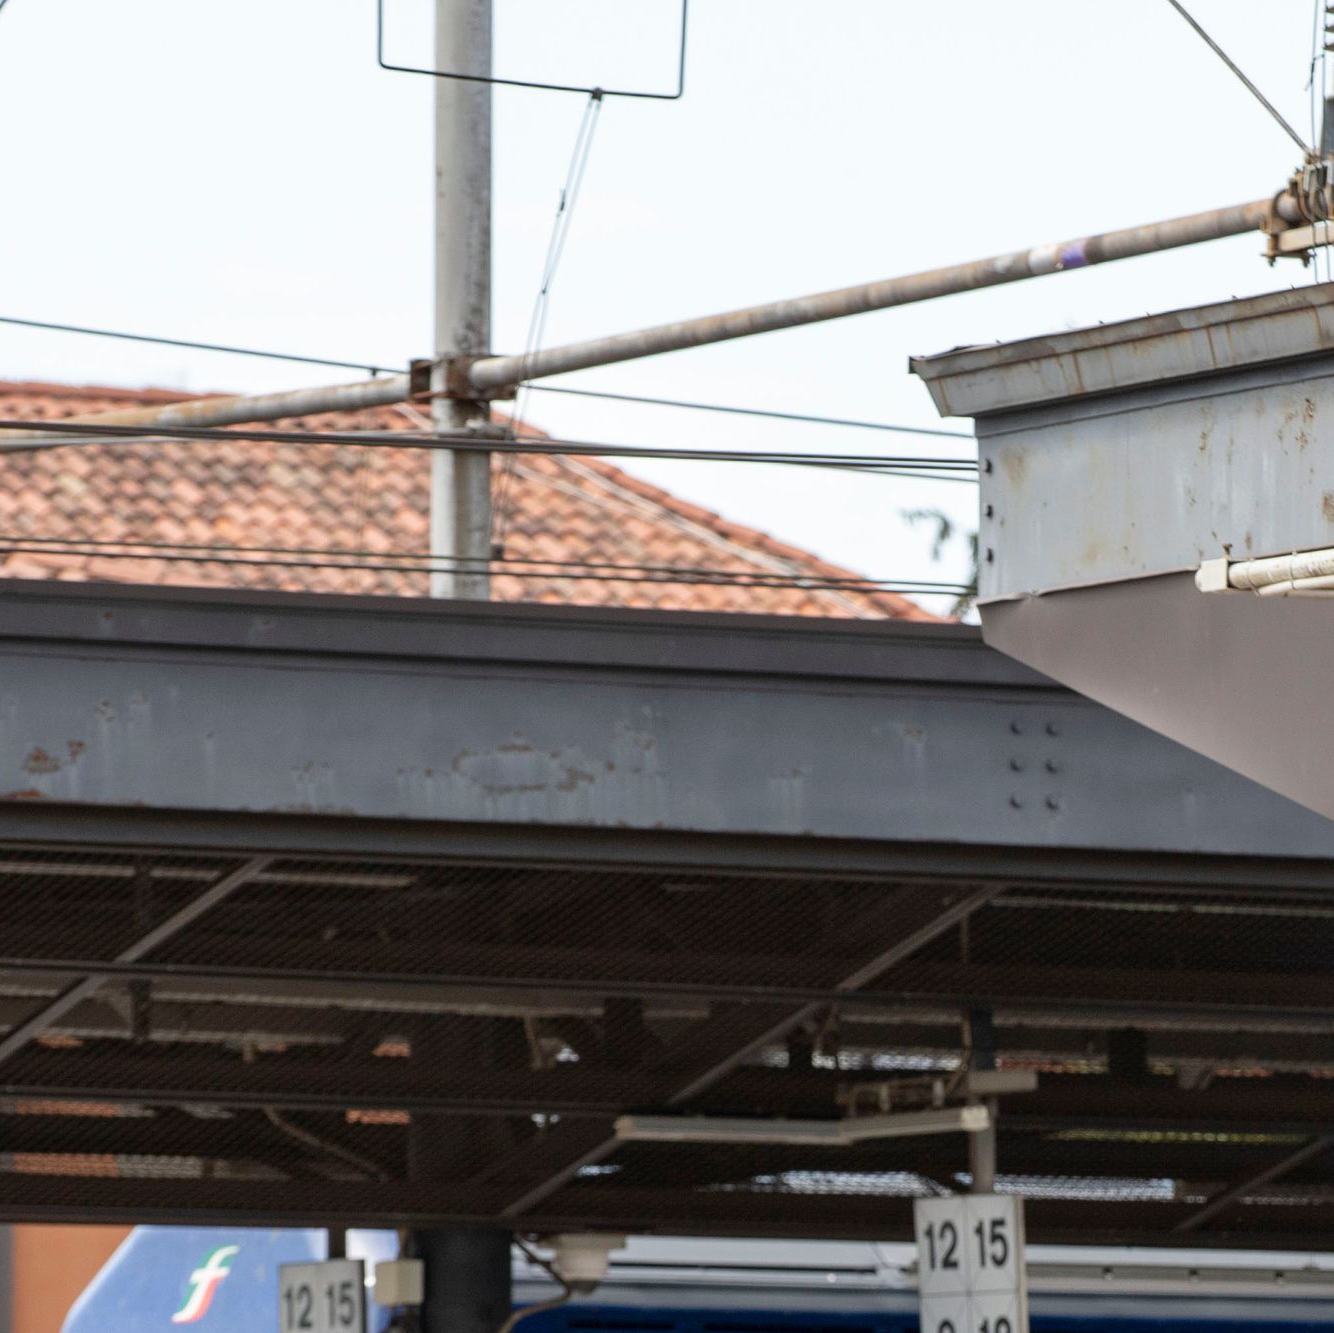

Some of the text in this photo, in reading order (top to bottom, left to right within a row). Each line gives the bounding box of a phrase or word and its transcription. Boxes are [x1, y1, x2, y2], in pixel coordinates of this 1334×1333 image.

[925, 1216, 1009, 1271] 12 15
[284, 1279, 355, 1331] 12 15
